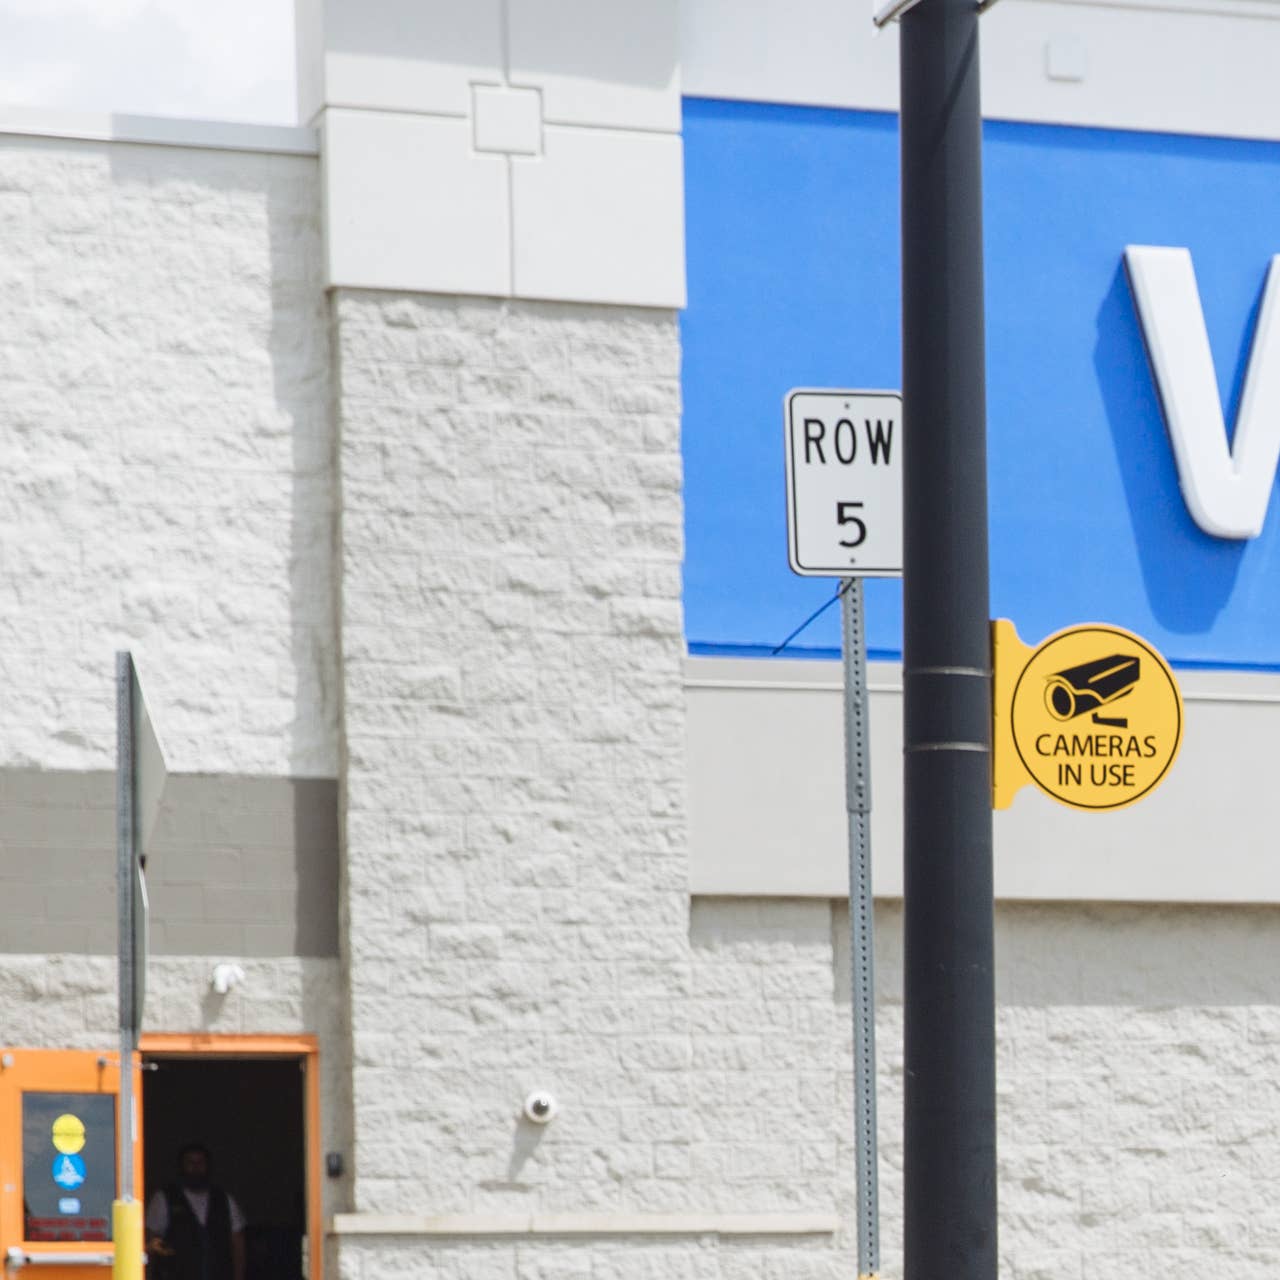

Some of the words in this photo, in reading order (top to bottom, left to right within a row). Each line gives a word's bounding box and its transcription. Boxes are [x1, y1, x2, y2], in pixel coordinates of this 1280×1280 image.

[803, 418, 894, 466] ROW
[836, 501, 868, 548] 5
[1035, 733, 1157, 758] CAMERAS
[1057, 763, 1082, 786] IN
[1090, 763, 1136, 787] USE
